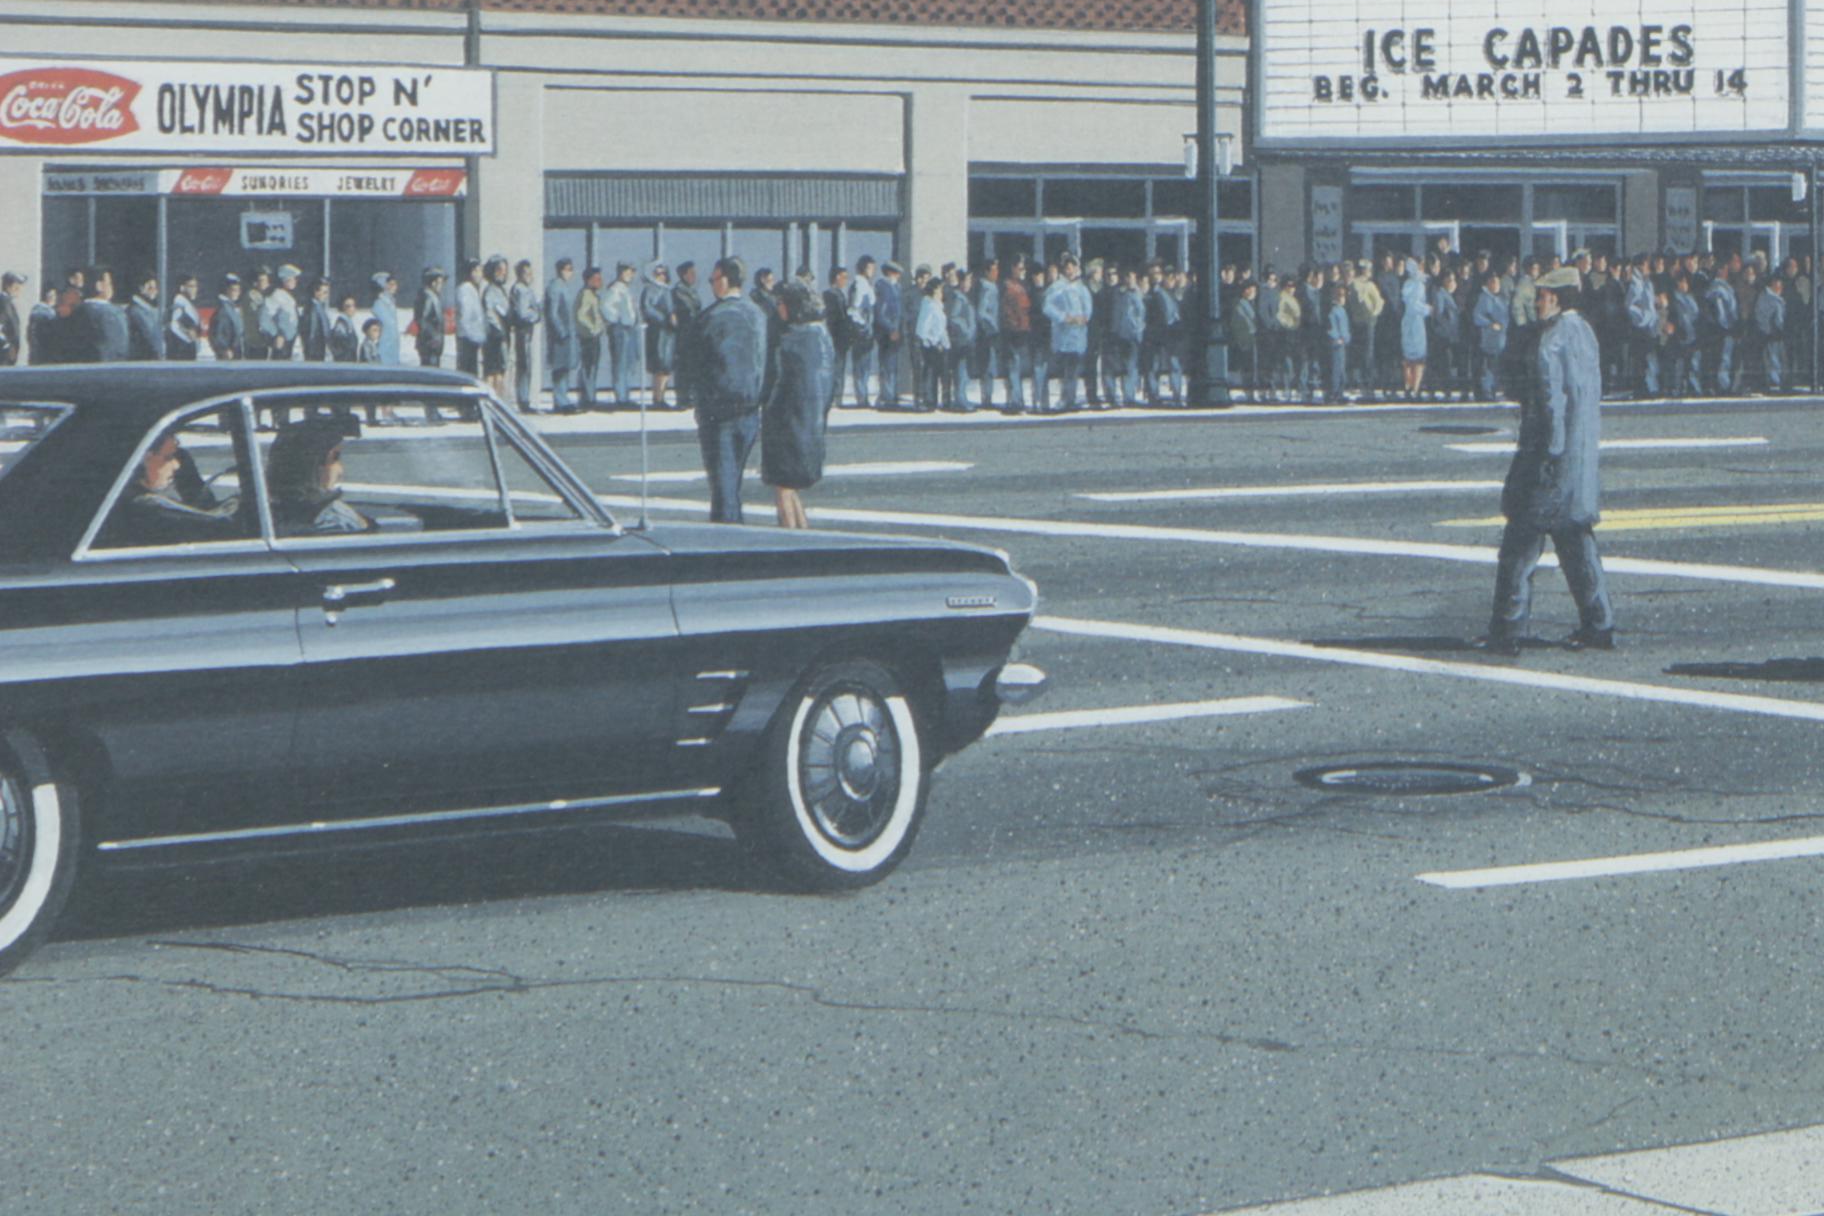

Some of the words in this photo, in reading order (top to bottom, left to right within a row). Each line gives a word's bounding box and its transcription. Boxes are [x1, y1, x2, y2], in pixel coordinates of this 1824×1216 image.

[1363, 28, 1437, 73] ICE
[1483, 24, 1696, 70] CAPADES
[294, 74, 376, 106] STOP
[1313, 74, 1390, 103] BEG.
[1421, 72, 1542, 100] MARCH
[1566, 72, 1585, 98] 2
[1605, 68, 1695, 96] THRU
[1715, 68, 1748, 98] 14
[157, 83, 288, 137] OLYMPIA
[295, 113, 374, 144] SHOP
[383, 117, 486, 144] CORNER
[241, 175, 310, 191] SUNDRIES
[337, 176, 396, 192] JEWELRY
